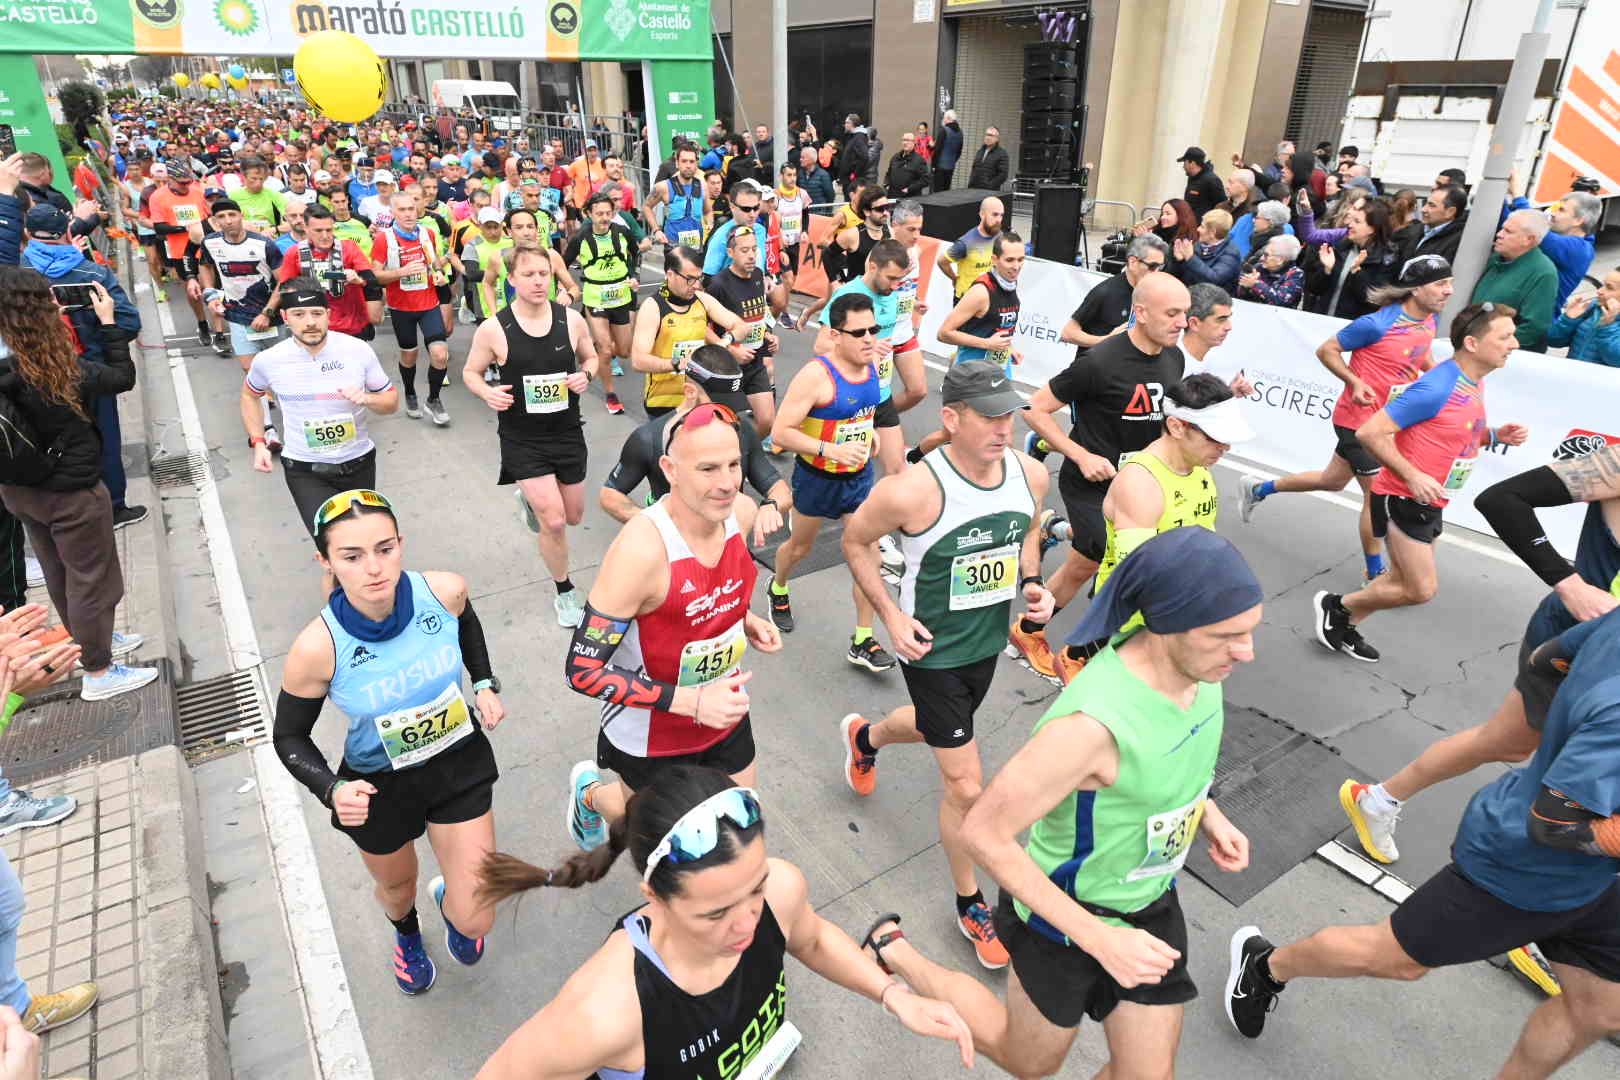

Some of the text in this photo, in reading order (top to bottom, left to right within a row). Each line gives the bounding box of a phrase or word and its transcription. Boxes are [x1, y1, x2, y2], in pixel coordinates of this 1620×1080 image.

[411, 4, 524, 38] CASTELLÓ
[638, 12, 692, 30] Castelló
[1013, 322, 1069, 346] VIER
[534, 383, 560, 399] 592
[1242, 380, 1335, 421] SCIRES
[315, 424, 346, 442] 569
[966, 560, 1005, 586] 300
[970, 582, 1000, 594] JAVIER
[573, 641, 600, 658] RUN
[694, 645, 734, 675] 451
[359, 644, 457, 709] TRISUD
[400, 720, 460, 754] ALEJANDRA
[401, 708, 449, 744] 627
